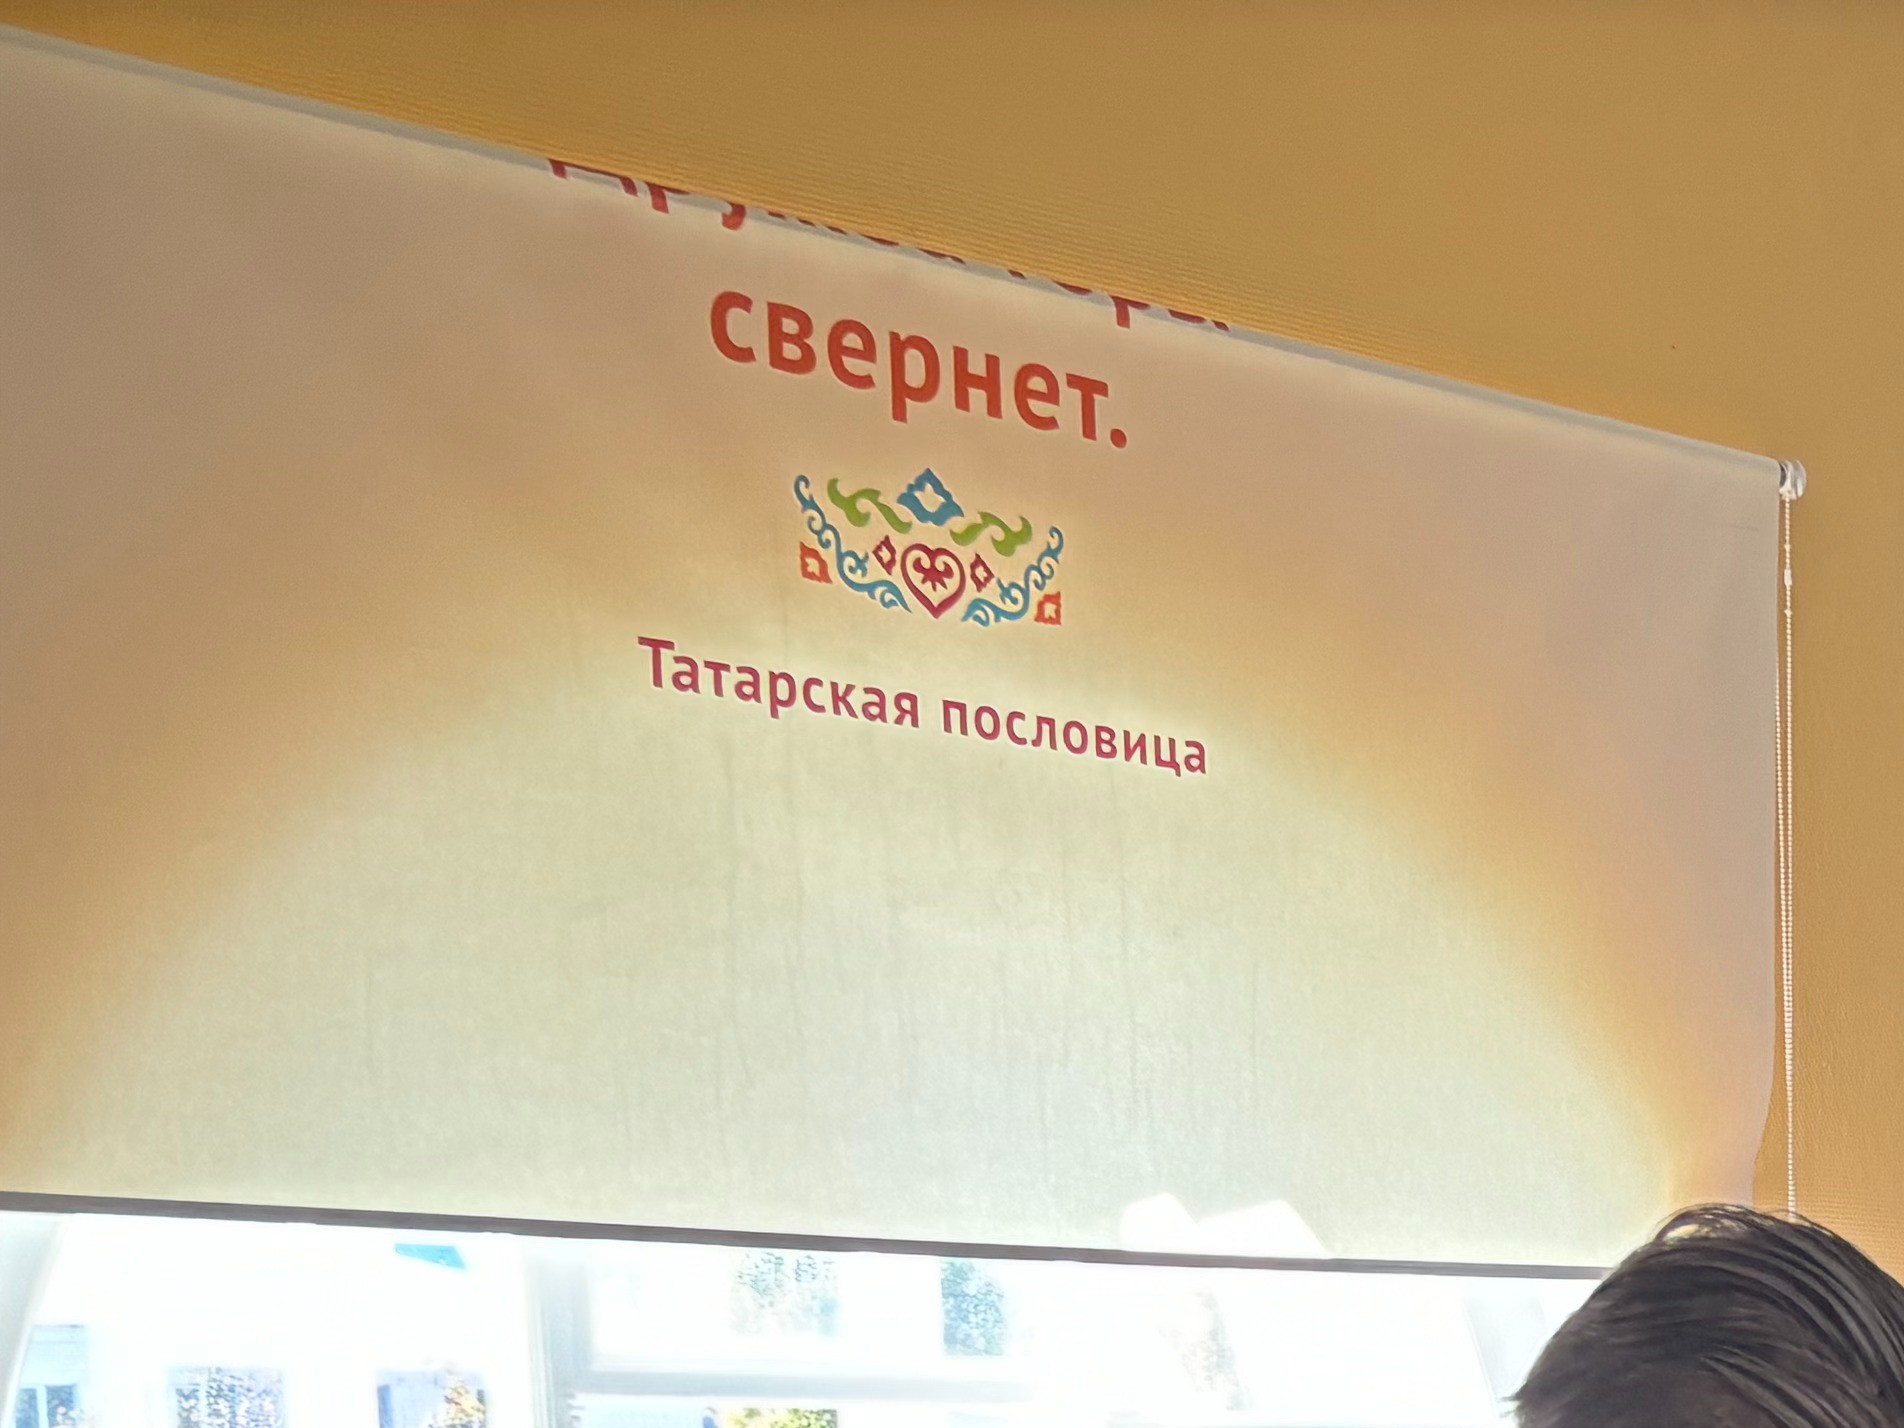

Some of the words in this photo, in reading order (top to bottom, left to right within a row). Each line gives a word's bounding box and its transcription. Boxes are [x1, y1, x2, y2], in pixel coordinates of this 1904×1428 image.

[709, 290, 1128, 449] свернет.
[637, 636, 921, 729] Татарская
[942, 697, 1209, 777] пословица
